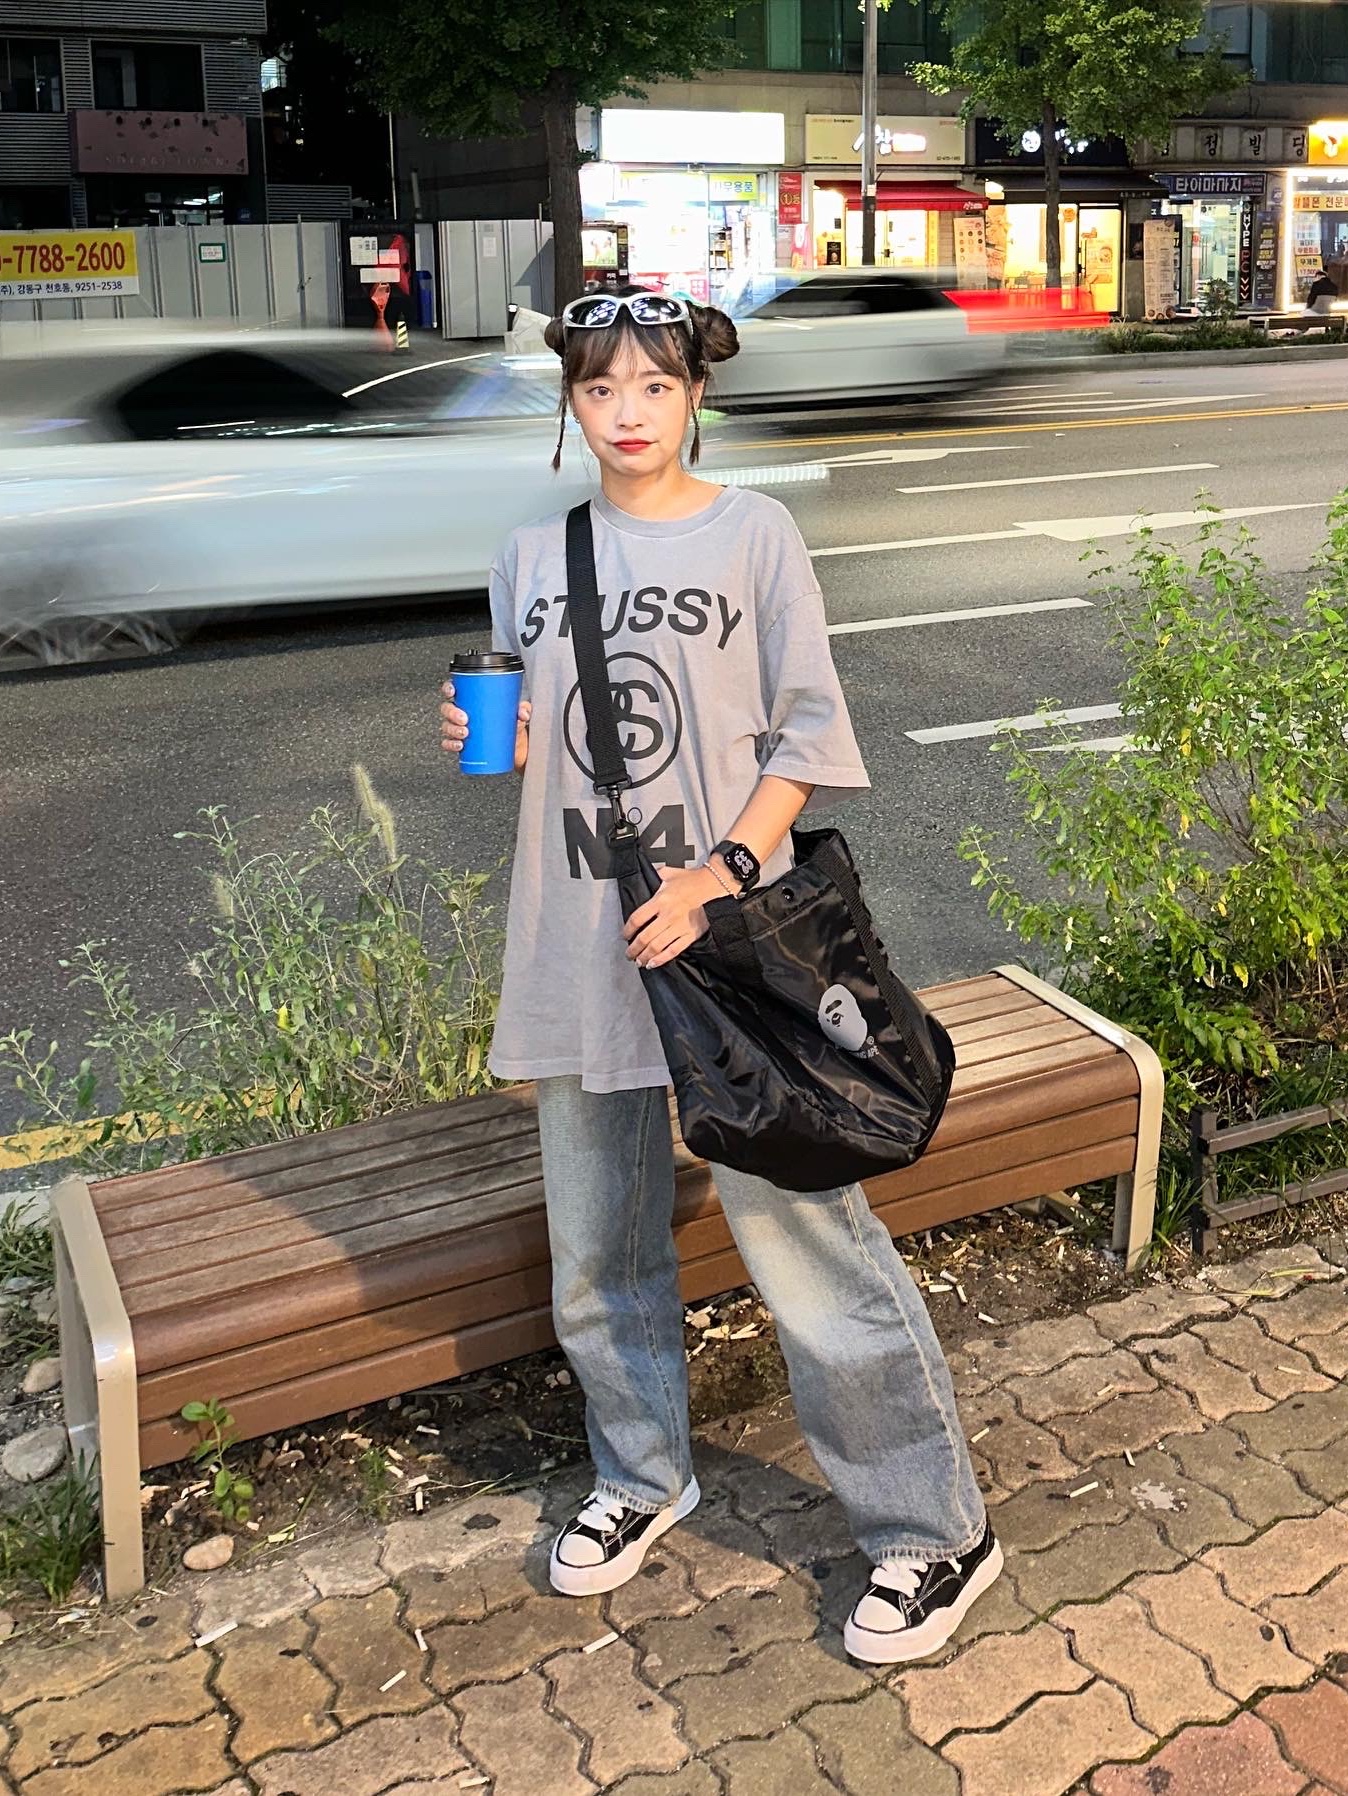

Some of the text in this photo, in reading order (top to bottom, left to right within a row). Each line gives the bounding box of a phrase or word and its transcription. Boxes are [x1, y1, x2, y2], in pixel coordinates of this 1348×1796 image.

[1243, 214, 1251, 247] HYPE
[0, 242, 125, 273] -7788-2600
[1241, 250, 1250, 273] PC
[75, 281, 122, 291] 9251-2538
[520, 586, 743, 650] STUSSY
